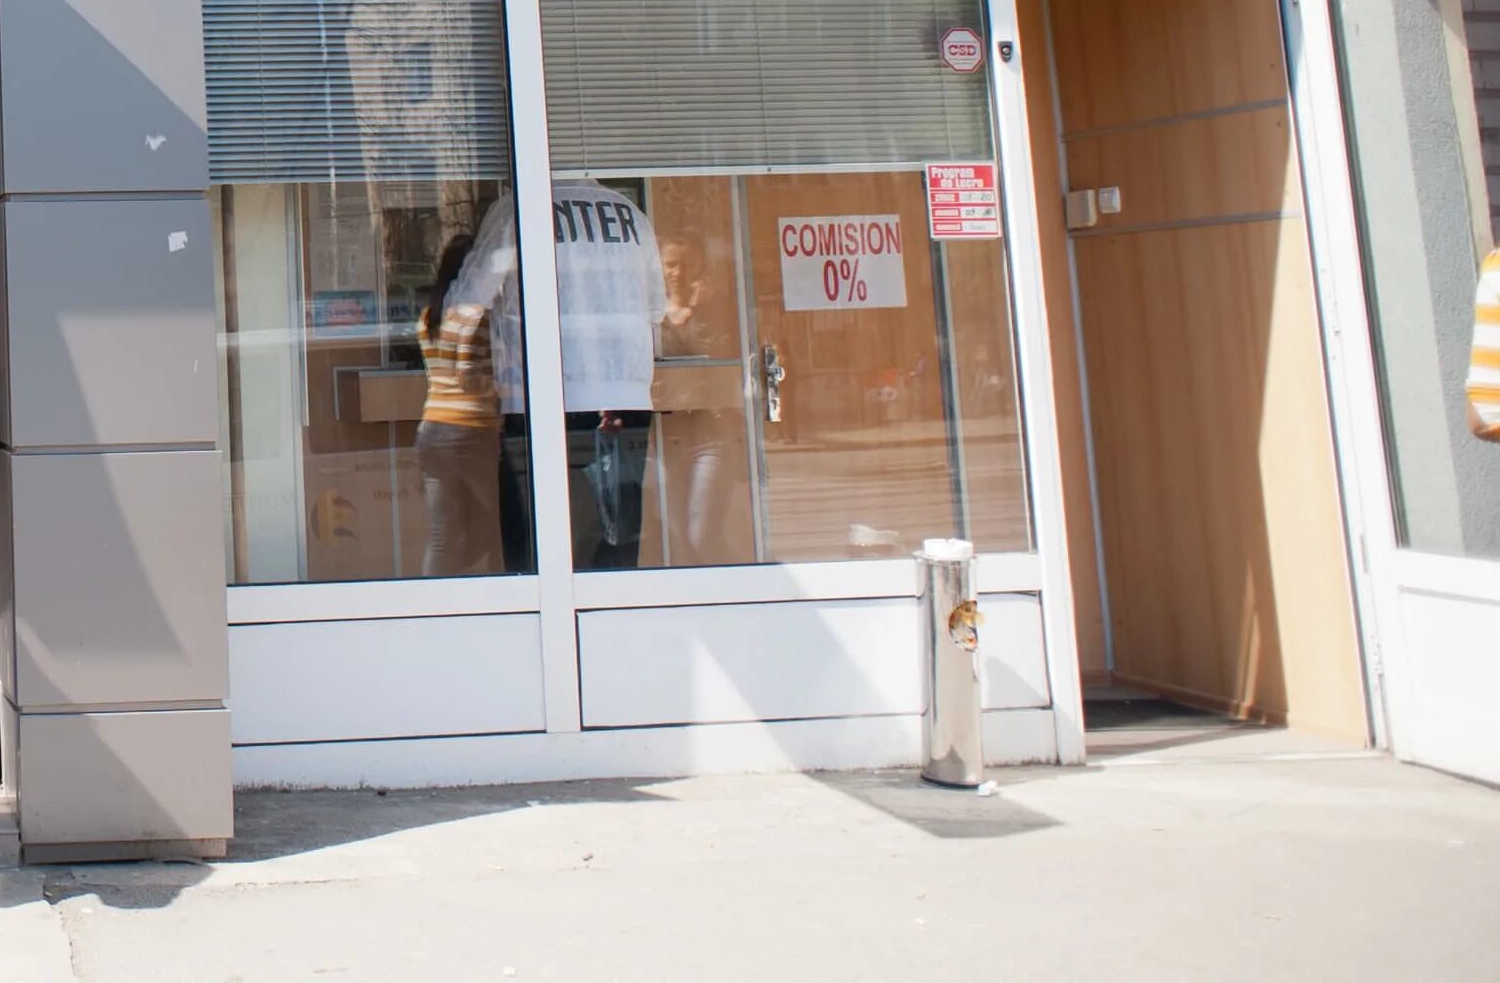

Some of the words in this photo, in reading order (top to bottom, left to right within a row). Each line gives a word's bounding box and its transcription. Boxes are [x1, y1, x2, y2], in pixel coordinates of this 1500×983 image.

[948, 44, 977, 56] CSD
[931, 167, 974, 179] Program
[940, 179, 953, 188] de
[955, 178, 984, 188] Lucru
[553, 200, 640, 246] NTER
[782, 221, 902, 257] COMISION
[823, 260, 867, 303] 0%
